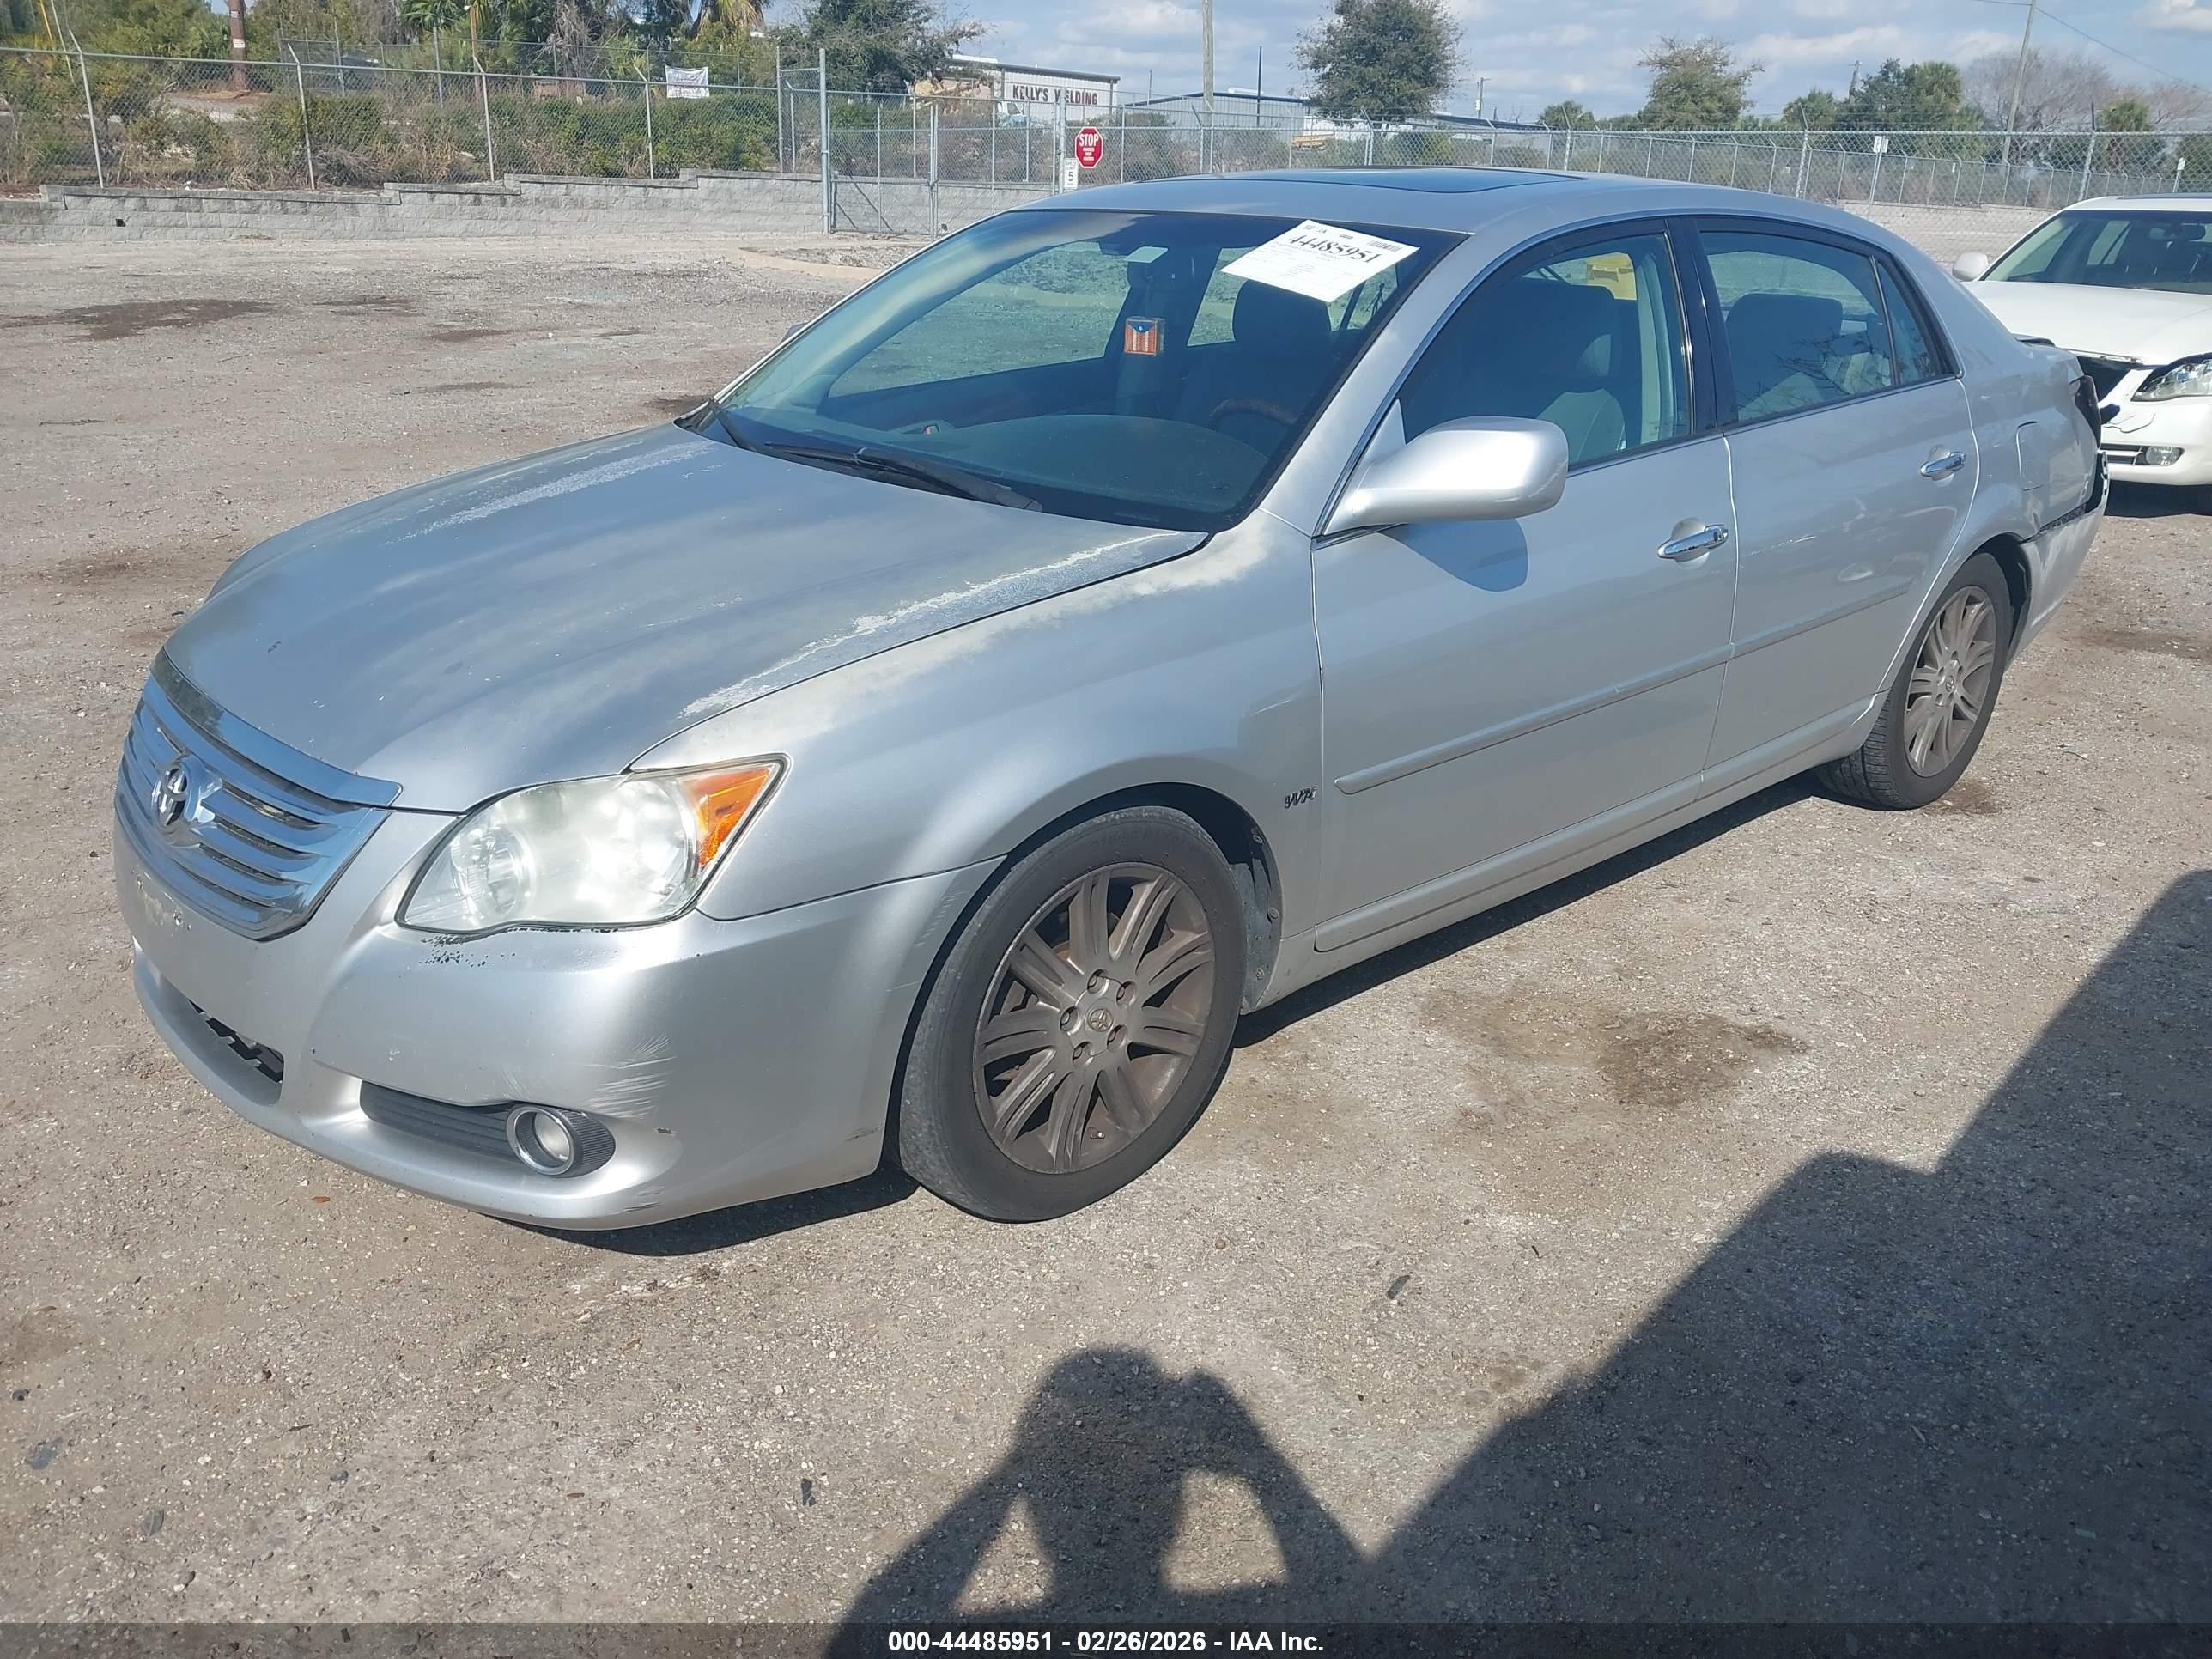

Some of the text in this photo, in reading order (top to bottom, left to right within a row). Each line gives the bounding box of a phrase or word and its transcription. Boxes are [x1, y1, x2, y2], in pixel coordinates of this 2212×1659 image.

[1012, 84, 1048, 101] KELLY'S
[1079, 133, 1099, 147] STOP
[1068, 171, 1074, 182] 5
[1289, 234, 1382, 263] 44485951
